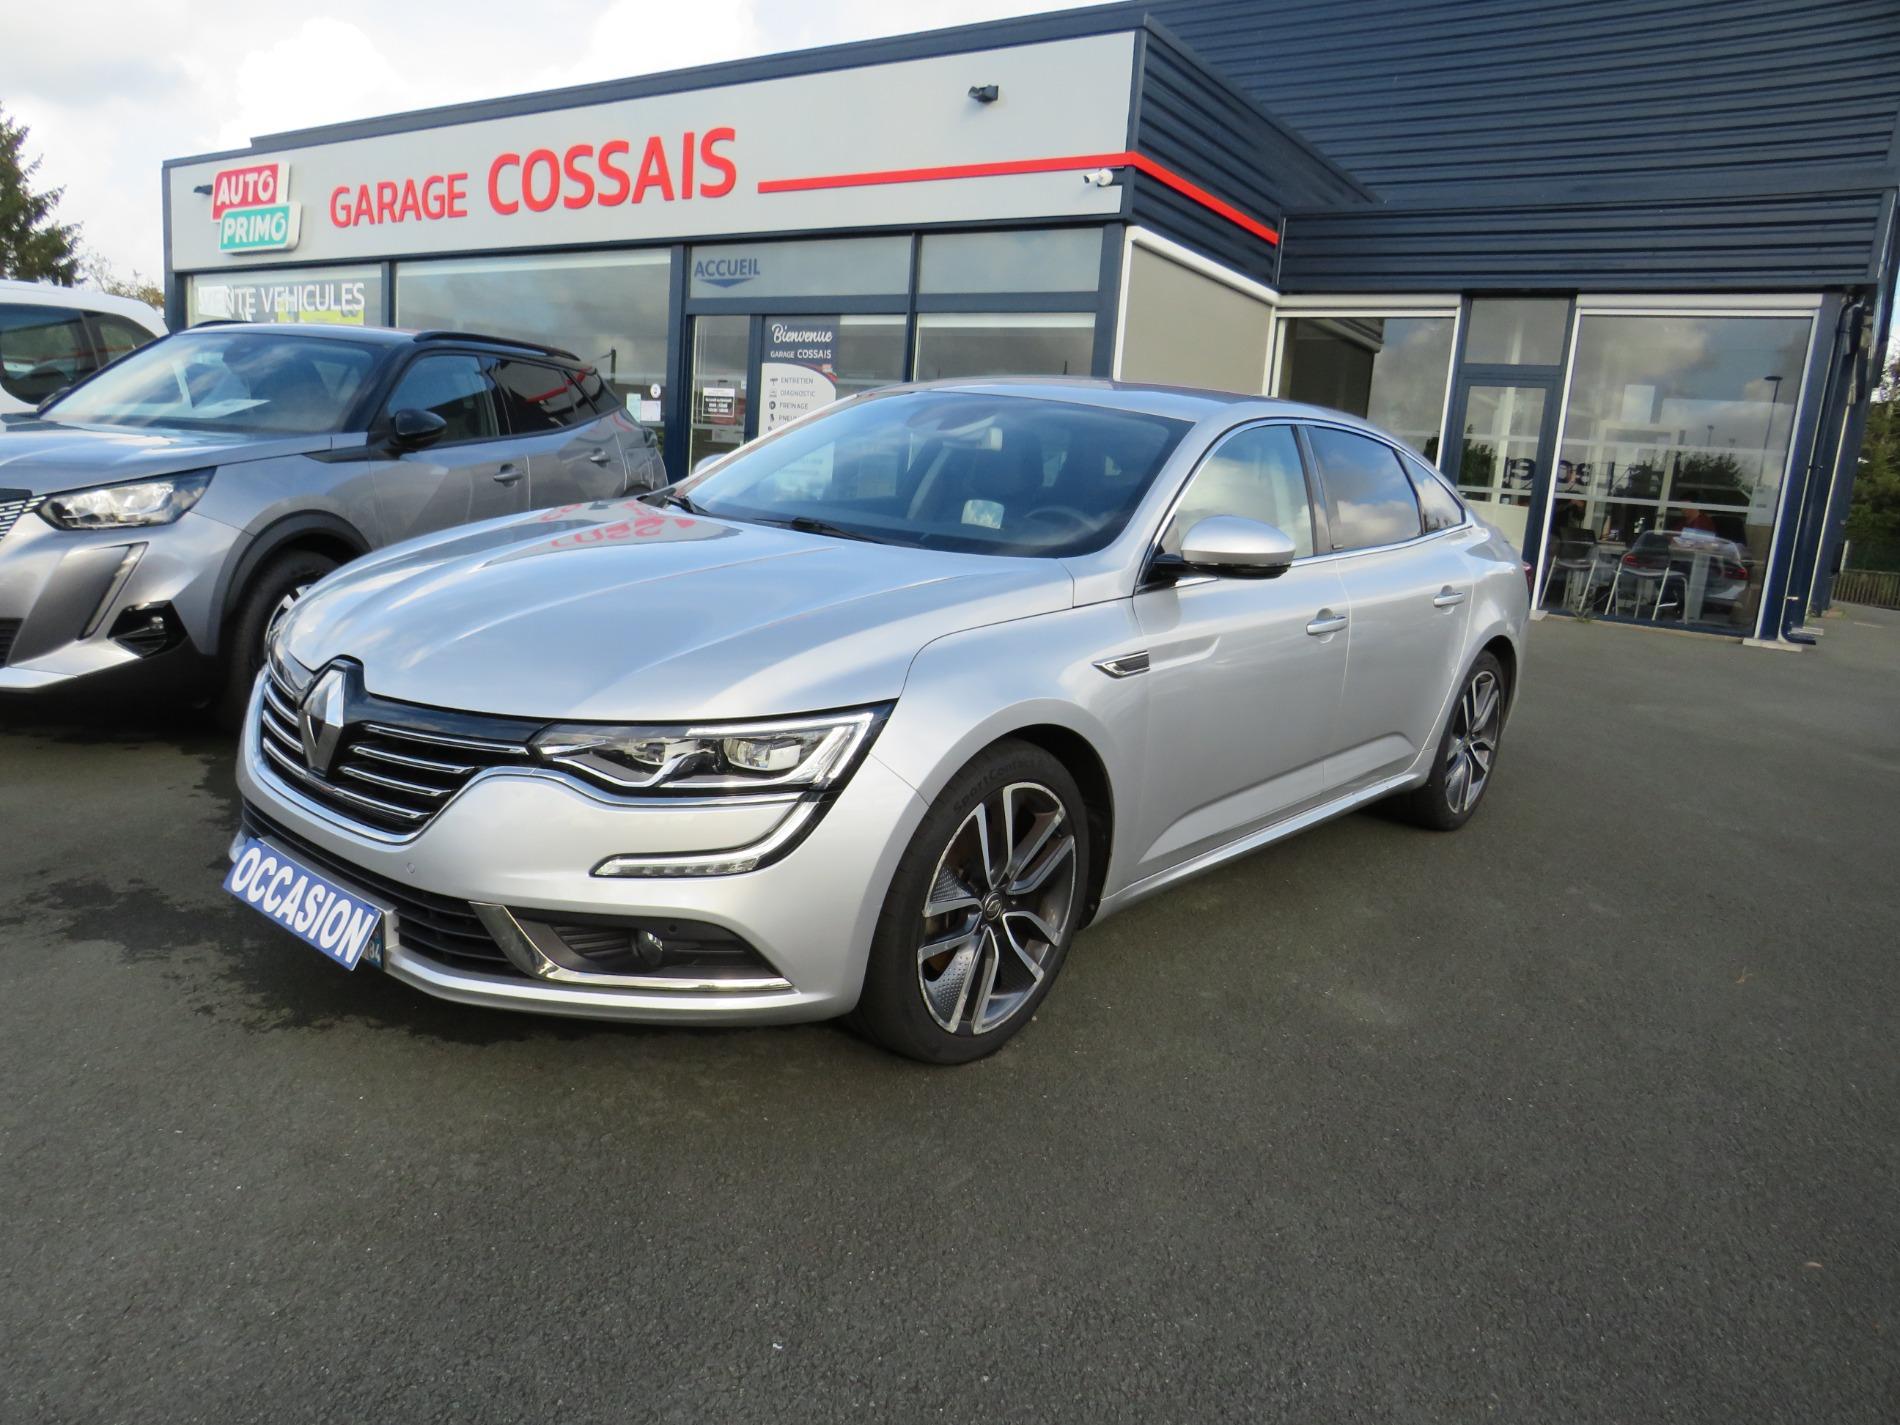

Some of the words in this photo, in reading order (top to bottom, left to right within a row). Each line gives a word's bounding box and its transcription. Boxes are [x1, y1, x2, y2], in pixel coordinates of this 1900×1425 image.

[216, 170, 274, 206] AUTO
[330, 172, 468, 228] GARAGE
[488, 127, 737, 216] COSSAIS
[223, 211, 286, 244] PRIMO
[694, 257, 761, 277] ACCUEIL
[260, 282, 365, 313] VEHICULES
[771, 323, 833, 344] Bienvenue
[770, 350, 795, 359] GARAGE
[797, 349, 832, 359] COSSAIS
[780, 377, 814, 385] ENTRETIEN
[779, 402, 809, 410] FREINAGE
[231, 847, 374, 963] OCCASION
